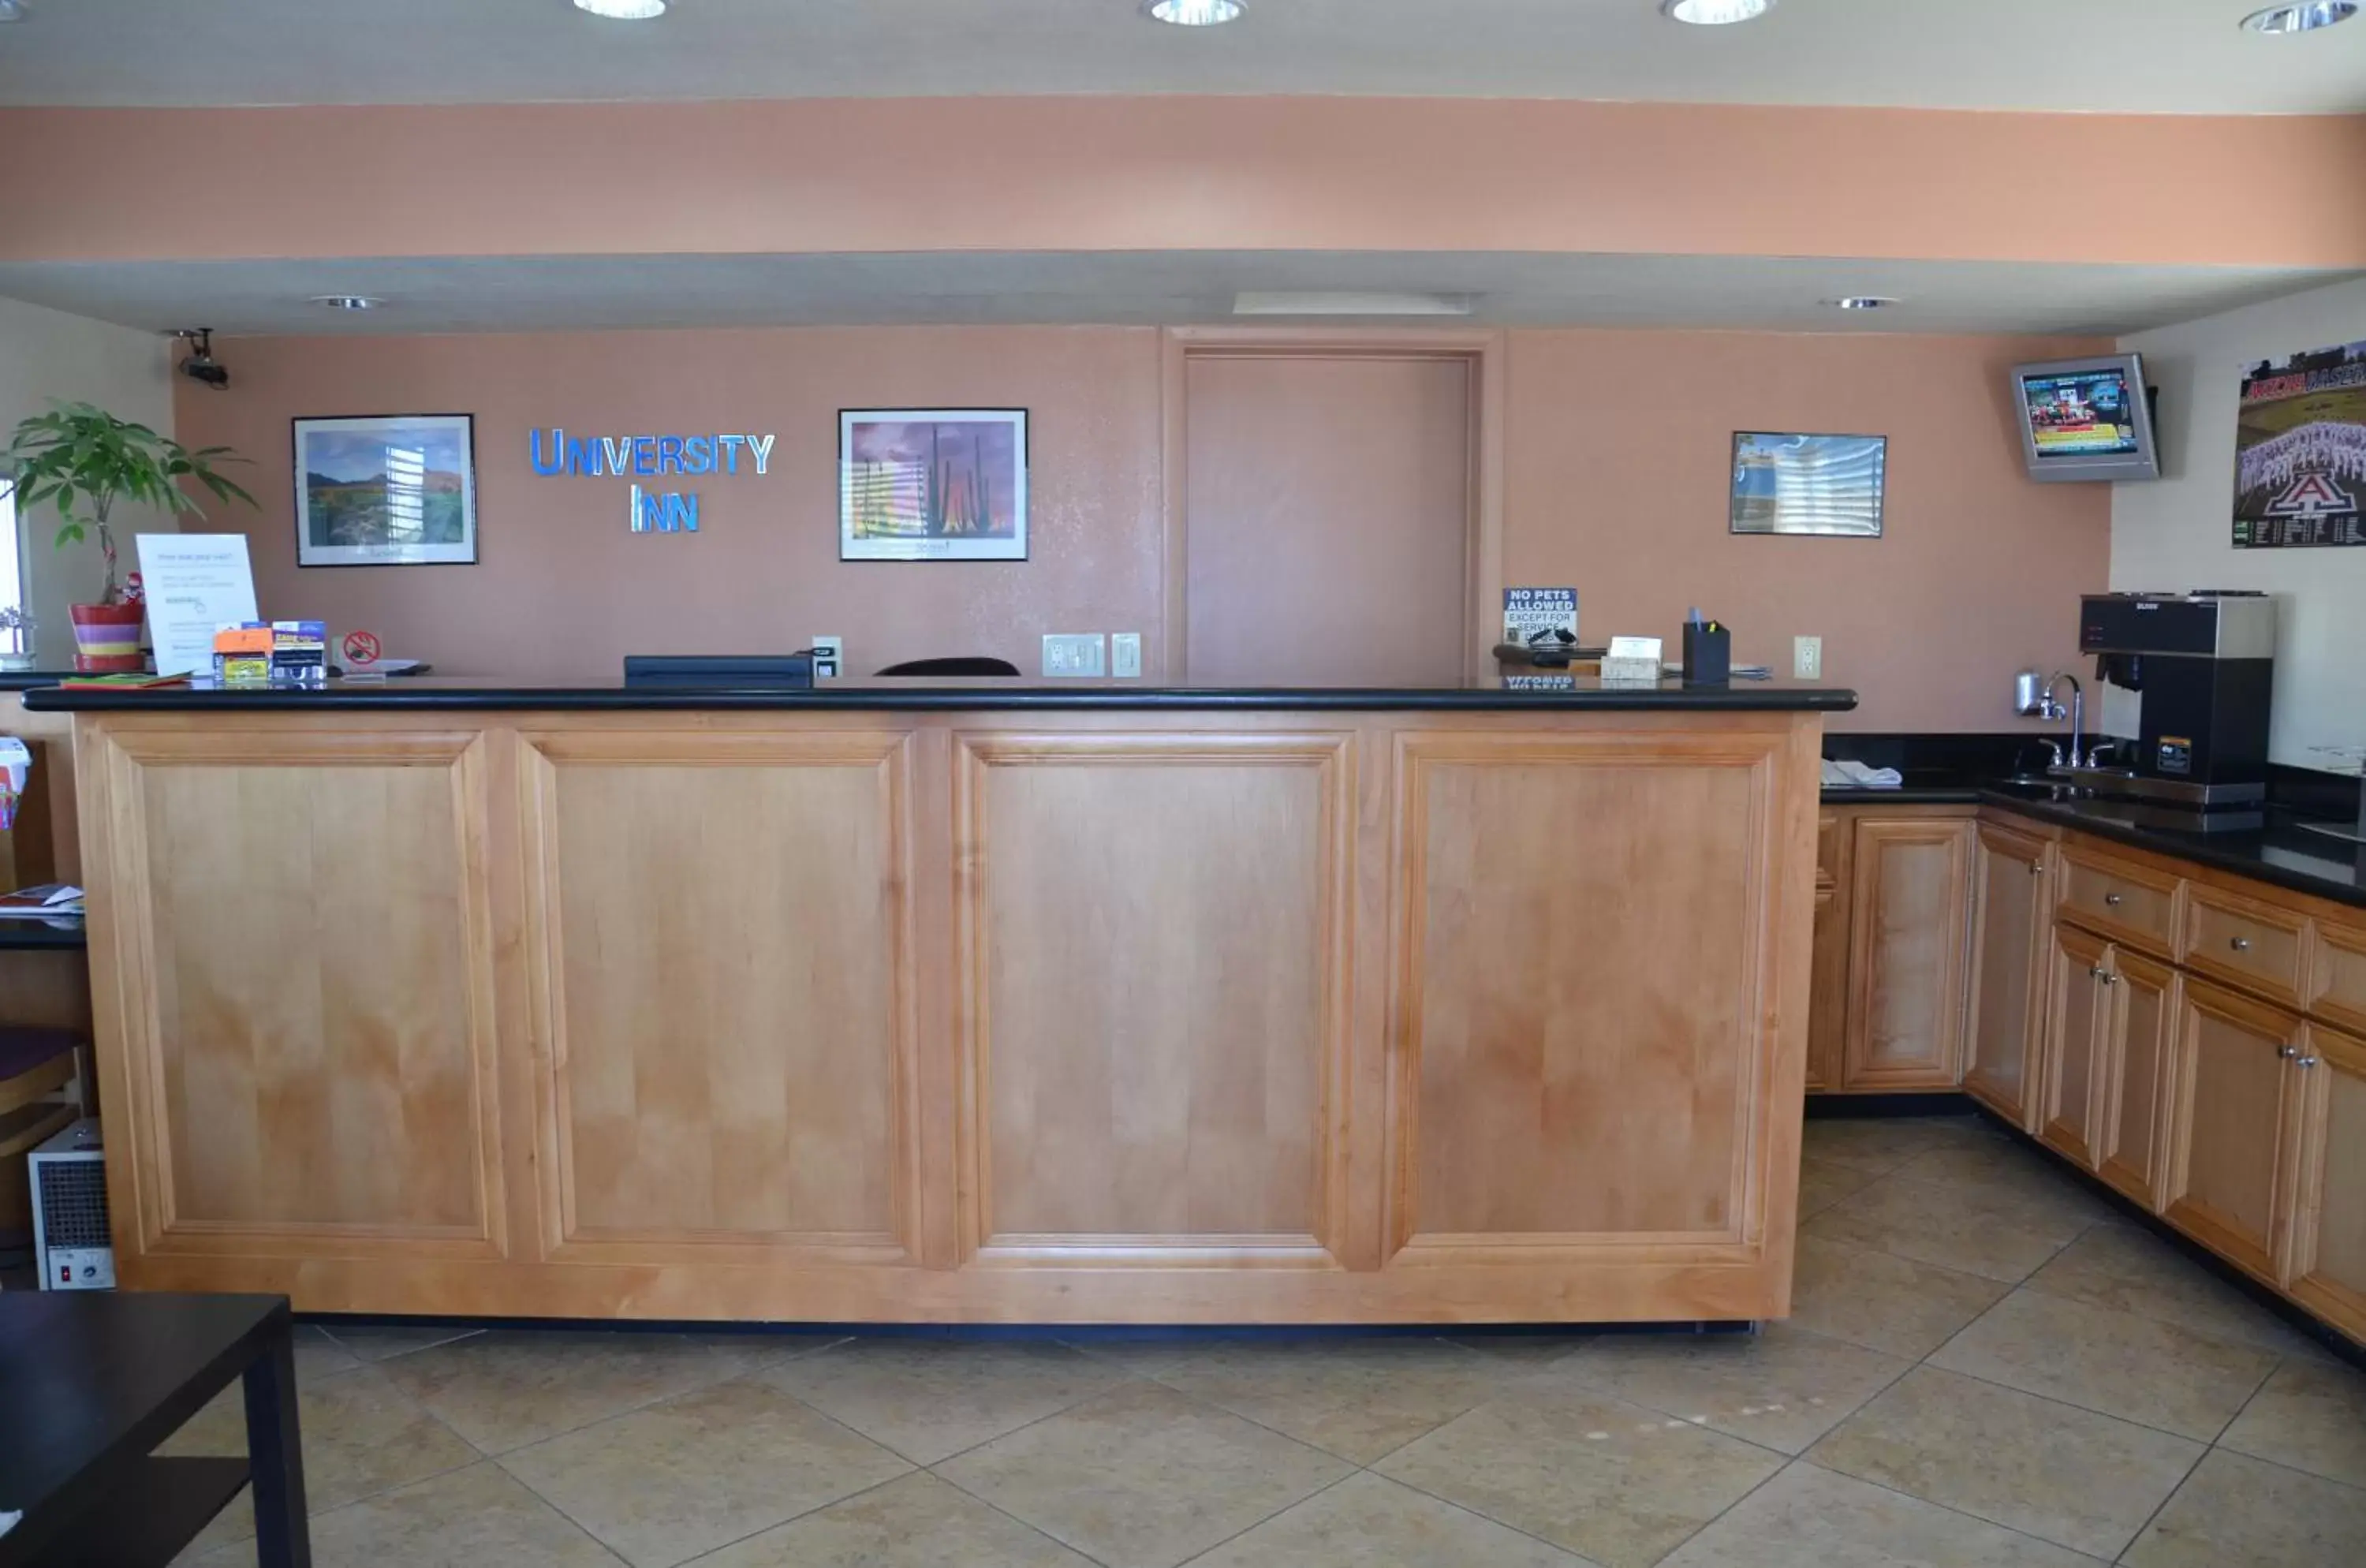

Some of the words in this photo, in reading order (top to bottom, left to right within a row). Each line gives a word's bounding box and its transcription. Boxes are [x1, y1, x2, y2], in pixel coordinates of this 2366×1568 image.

[530, 427, 775, 476] UNIVERSITY
[630, 483, 699, 533] INN
[1510, 590, 1531, 599] NO
[1534, 590, 1569, 599] PETS
[1508, 601, 1573, 610] ALLOWED
[1551, 613, 1569, 622] FOR
